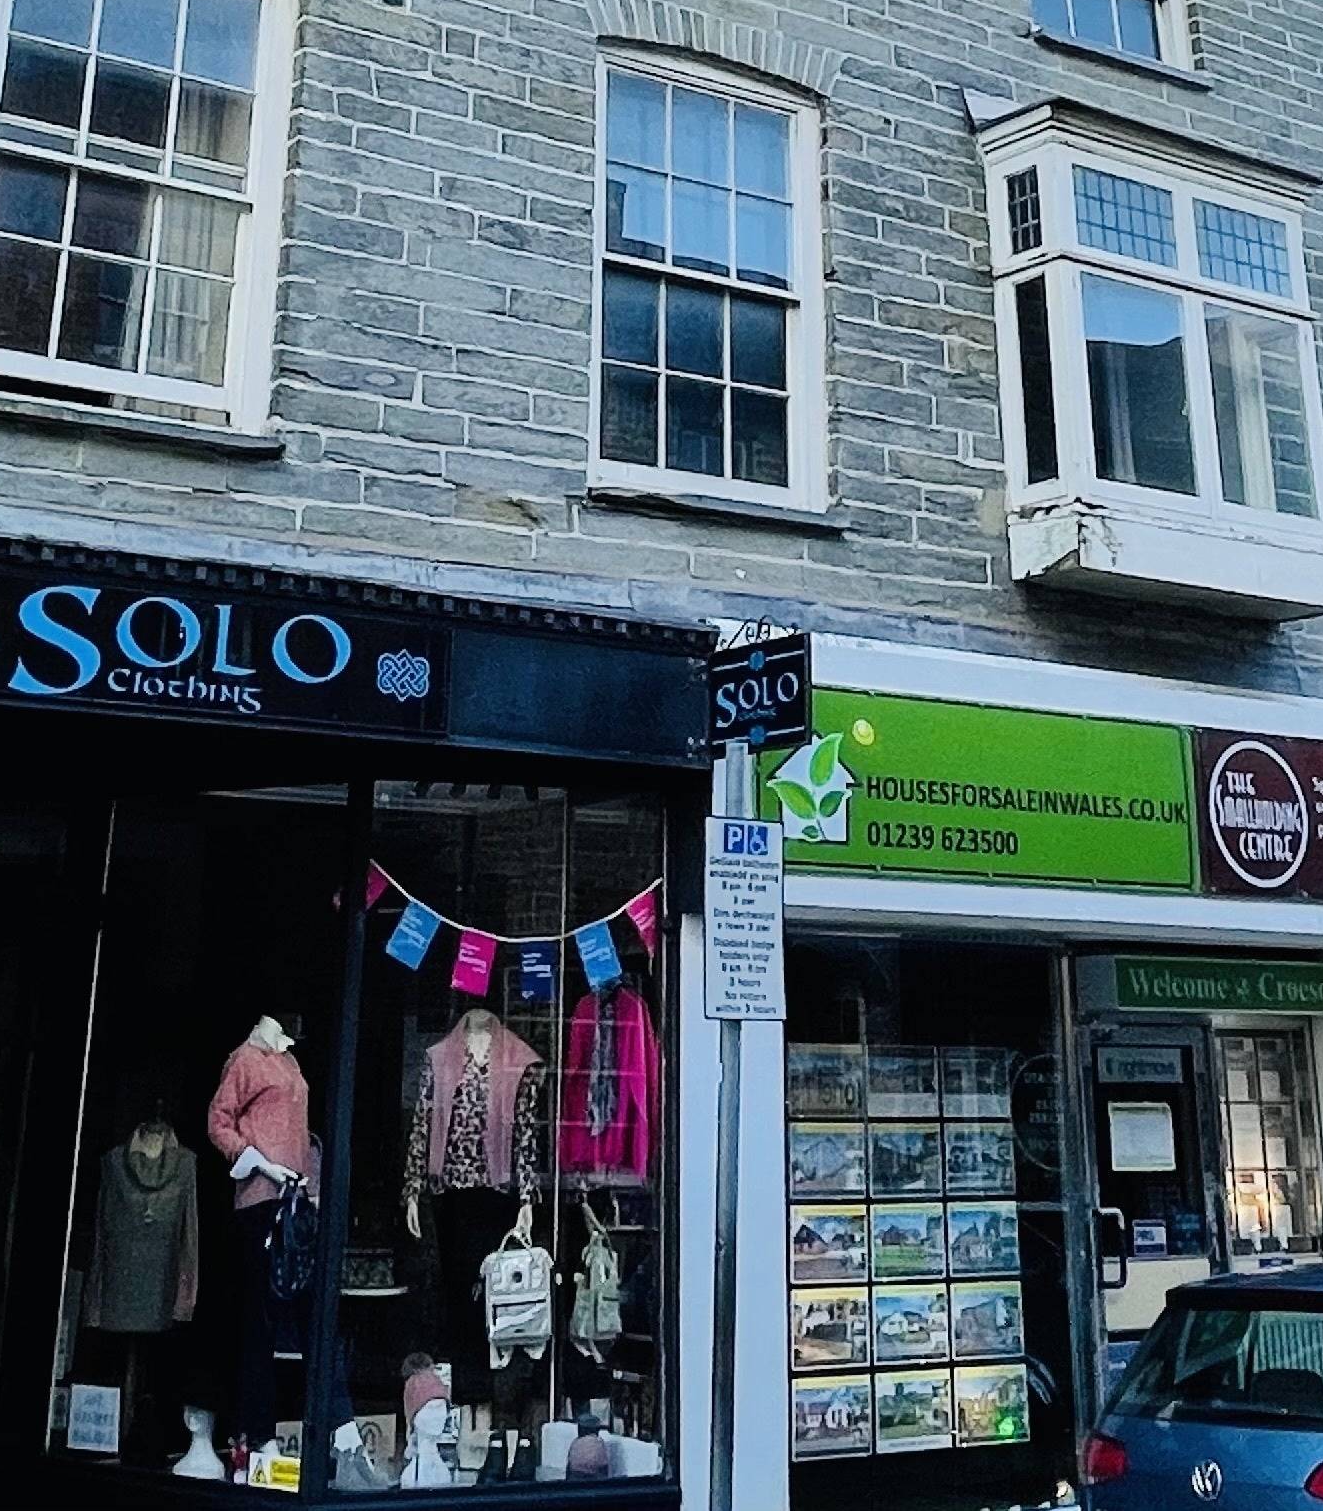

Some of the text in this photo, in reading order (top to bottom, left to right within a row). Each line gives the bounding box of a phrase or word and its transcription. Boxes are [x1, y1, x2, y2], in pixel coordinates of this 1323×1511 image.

[8, 585, 352, 695] SOLO
[716, 672, 799, 728] SOLO
[866, 776, 1186, 824] HOUSESFORSALEINWALES.CO.UK
[867, 821, 1019, 856] 01239 623500
[1239, 821, 1294, 863] CENTRE
[1129, 968, 1227, 1000] Welcome
